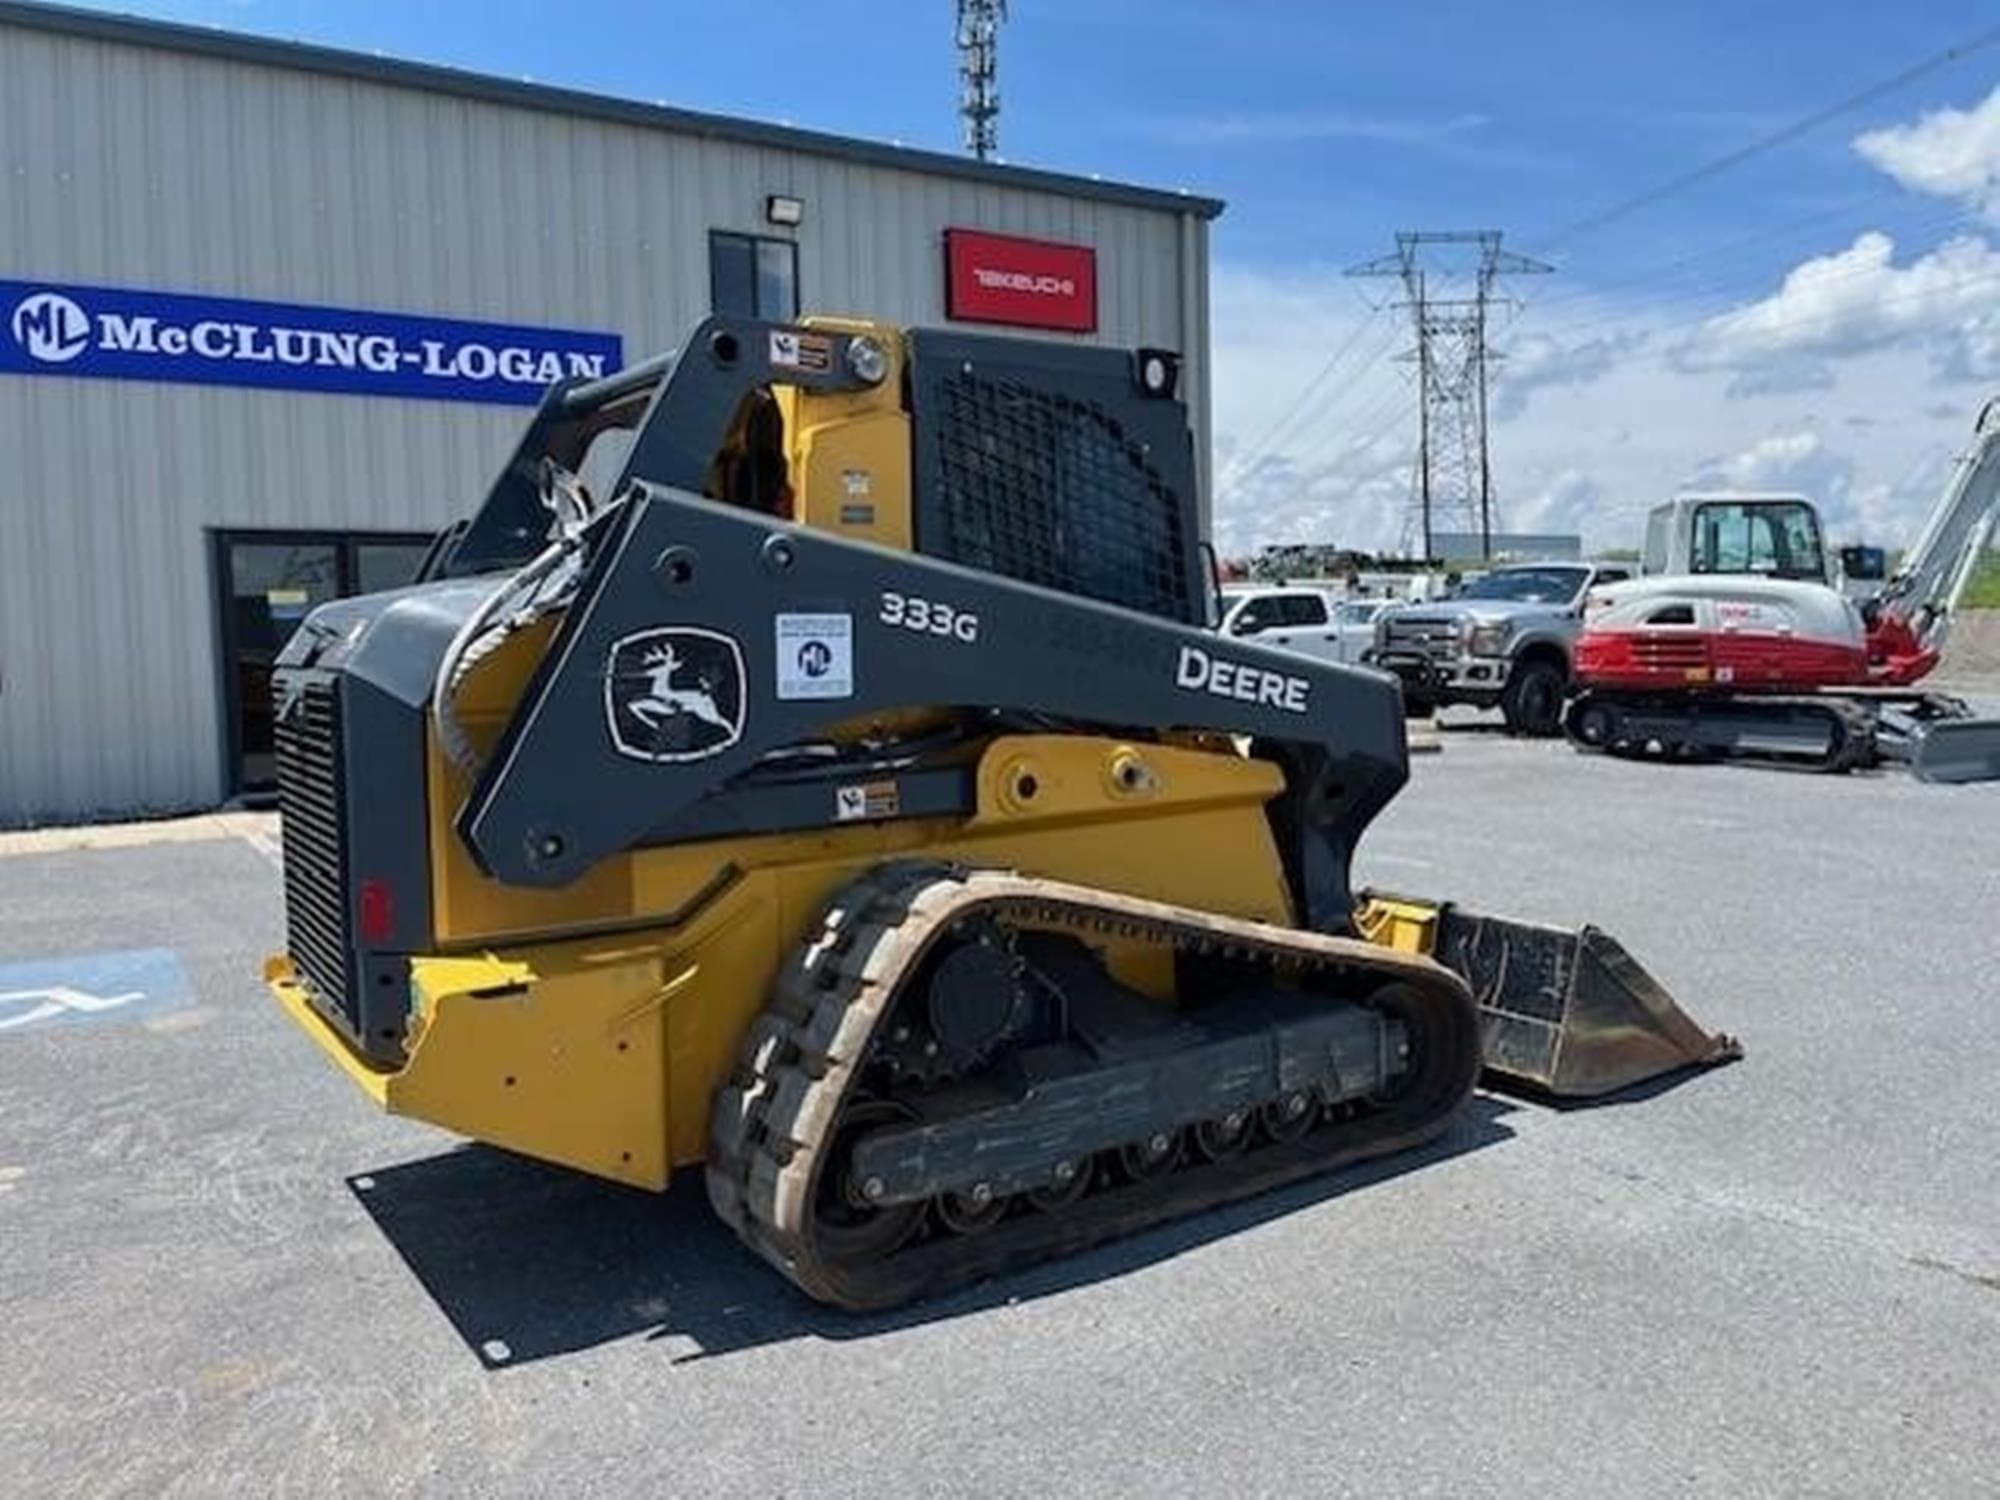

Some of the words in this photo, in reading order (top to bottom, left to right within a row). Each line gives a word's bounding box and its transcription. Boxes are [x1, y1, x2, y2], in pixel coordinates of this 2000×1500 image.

[98, 313, 605, 384] McCLUNG-LOGAN
[879, 592, 978, 642] 333G
[1176, 646, 1310, 712] DEERE
